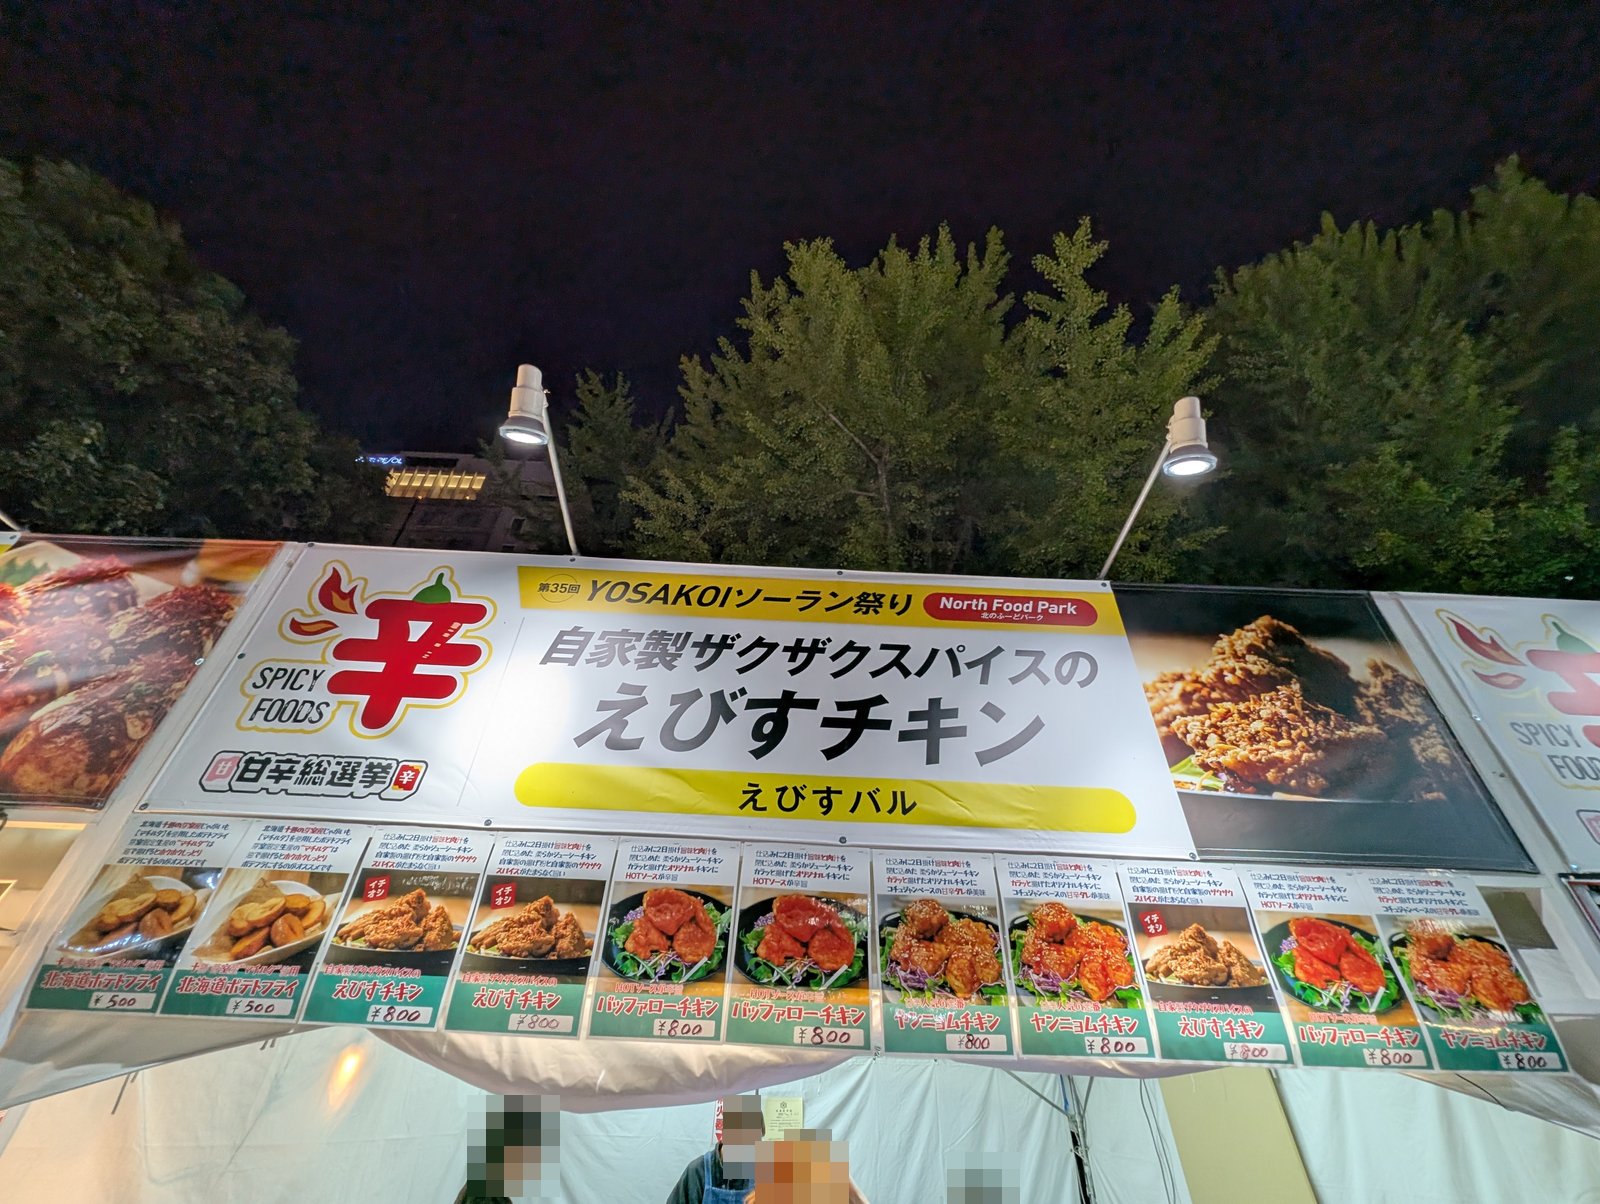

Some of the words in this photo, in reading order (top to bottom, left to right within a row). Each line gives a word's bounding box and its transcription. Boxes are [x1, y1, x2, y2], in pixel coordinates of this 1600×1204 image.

[537, 582, 581, 594] 第35回
[586, 579, 912, 616] YOSAKOIソーラン祭り
[940, 597, 987, 611] North
[992, 599, 1033, 613] Food
[1038, 600, 1077, 615] Park
[539, 625, 1099, 689] 自家製ザクザクスパイスの
[252, 666, 326, 693] SPICY
[248, 698, 330, 724] FOODS
[572, 682, 1046, 767] えびすチキン
[1510, 722, 1581, 748] SPICY
[235, 756, 393, 788] 甘辛総選挙
[738, 781, 918, 818] えびすバル
[367, 888, 385, 899] オシ
[369, 879, 386, 889] イチ
[495, 886, 512, 896] イチ
[495, 896, 512, 906] オシ
[1144, 913, 1159, 924] イチ
[1147, 924, 1163, 934] オシ
[42, 971, 162, 991] 北海道ポテトフライ
[177, 977, 298, 997] 北海道ポテトフライ
[333, 979, 423, 1001] えびすチキン
[232, 1000, 275, 1013] ¥500
[473, 988, 561, 1009] えびすチキン
[597, 995, 719, 1017] バッファローチキン
[371, 1006, 421, 1022] ¥800
[732, 1002, 865, 1026] バッファローチキン
[894, 1009, 1000, 1032] ヤンニョムチキン
[1031, 1012, 1138, 1034] ヤンニョムチキン
[658, 1020, 703, 1037] ¥800
[799, 1026, 851, 1045] ¥800
[1178, 1016, 1264, 1039] えびすチキン
[1299, 1025, 1420, 1048] バッファローチキン
[1087, 1037, 1136, 1055] ¥800
[1367, 1048, 1413, 1066] ¥800
[1501, 1053, 1548, 1069] ¥800
